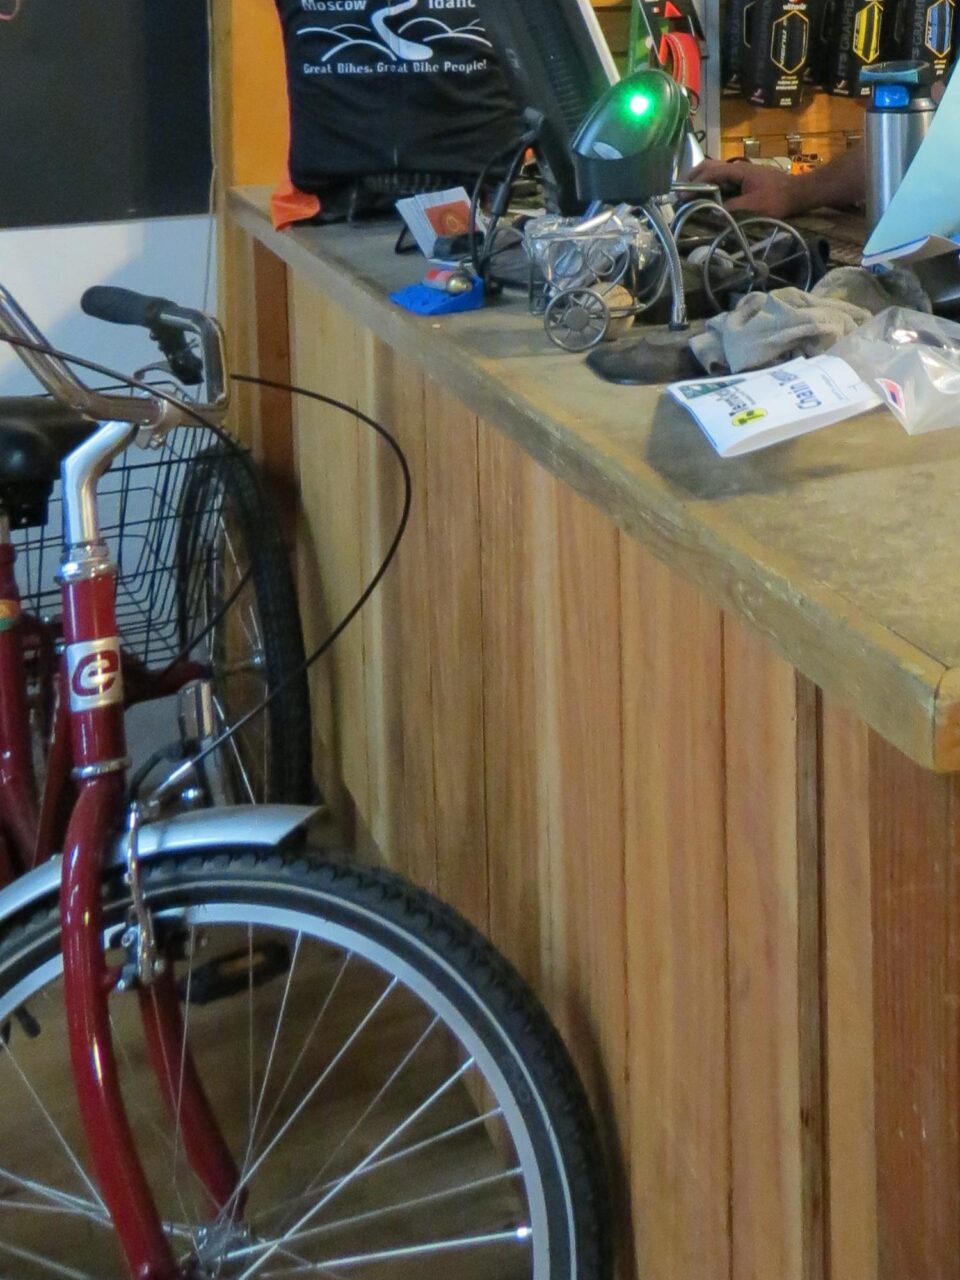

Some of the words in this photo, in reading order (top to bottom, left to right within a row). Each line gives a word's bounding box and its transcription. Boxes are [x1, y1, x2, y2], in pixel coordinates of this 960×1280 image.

[303, 62, 332, 75] Great
[337, 61, 373, 75] Bikes.
[412, 60, 440, 73] Bike
[444, 58, 487, 74] People!
